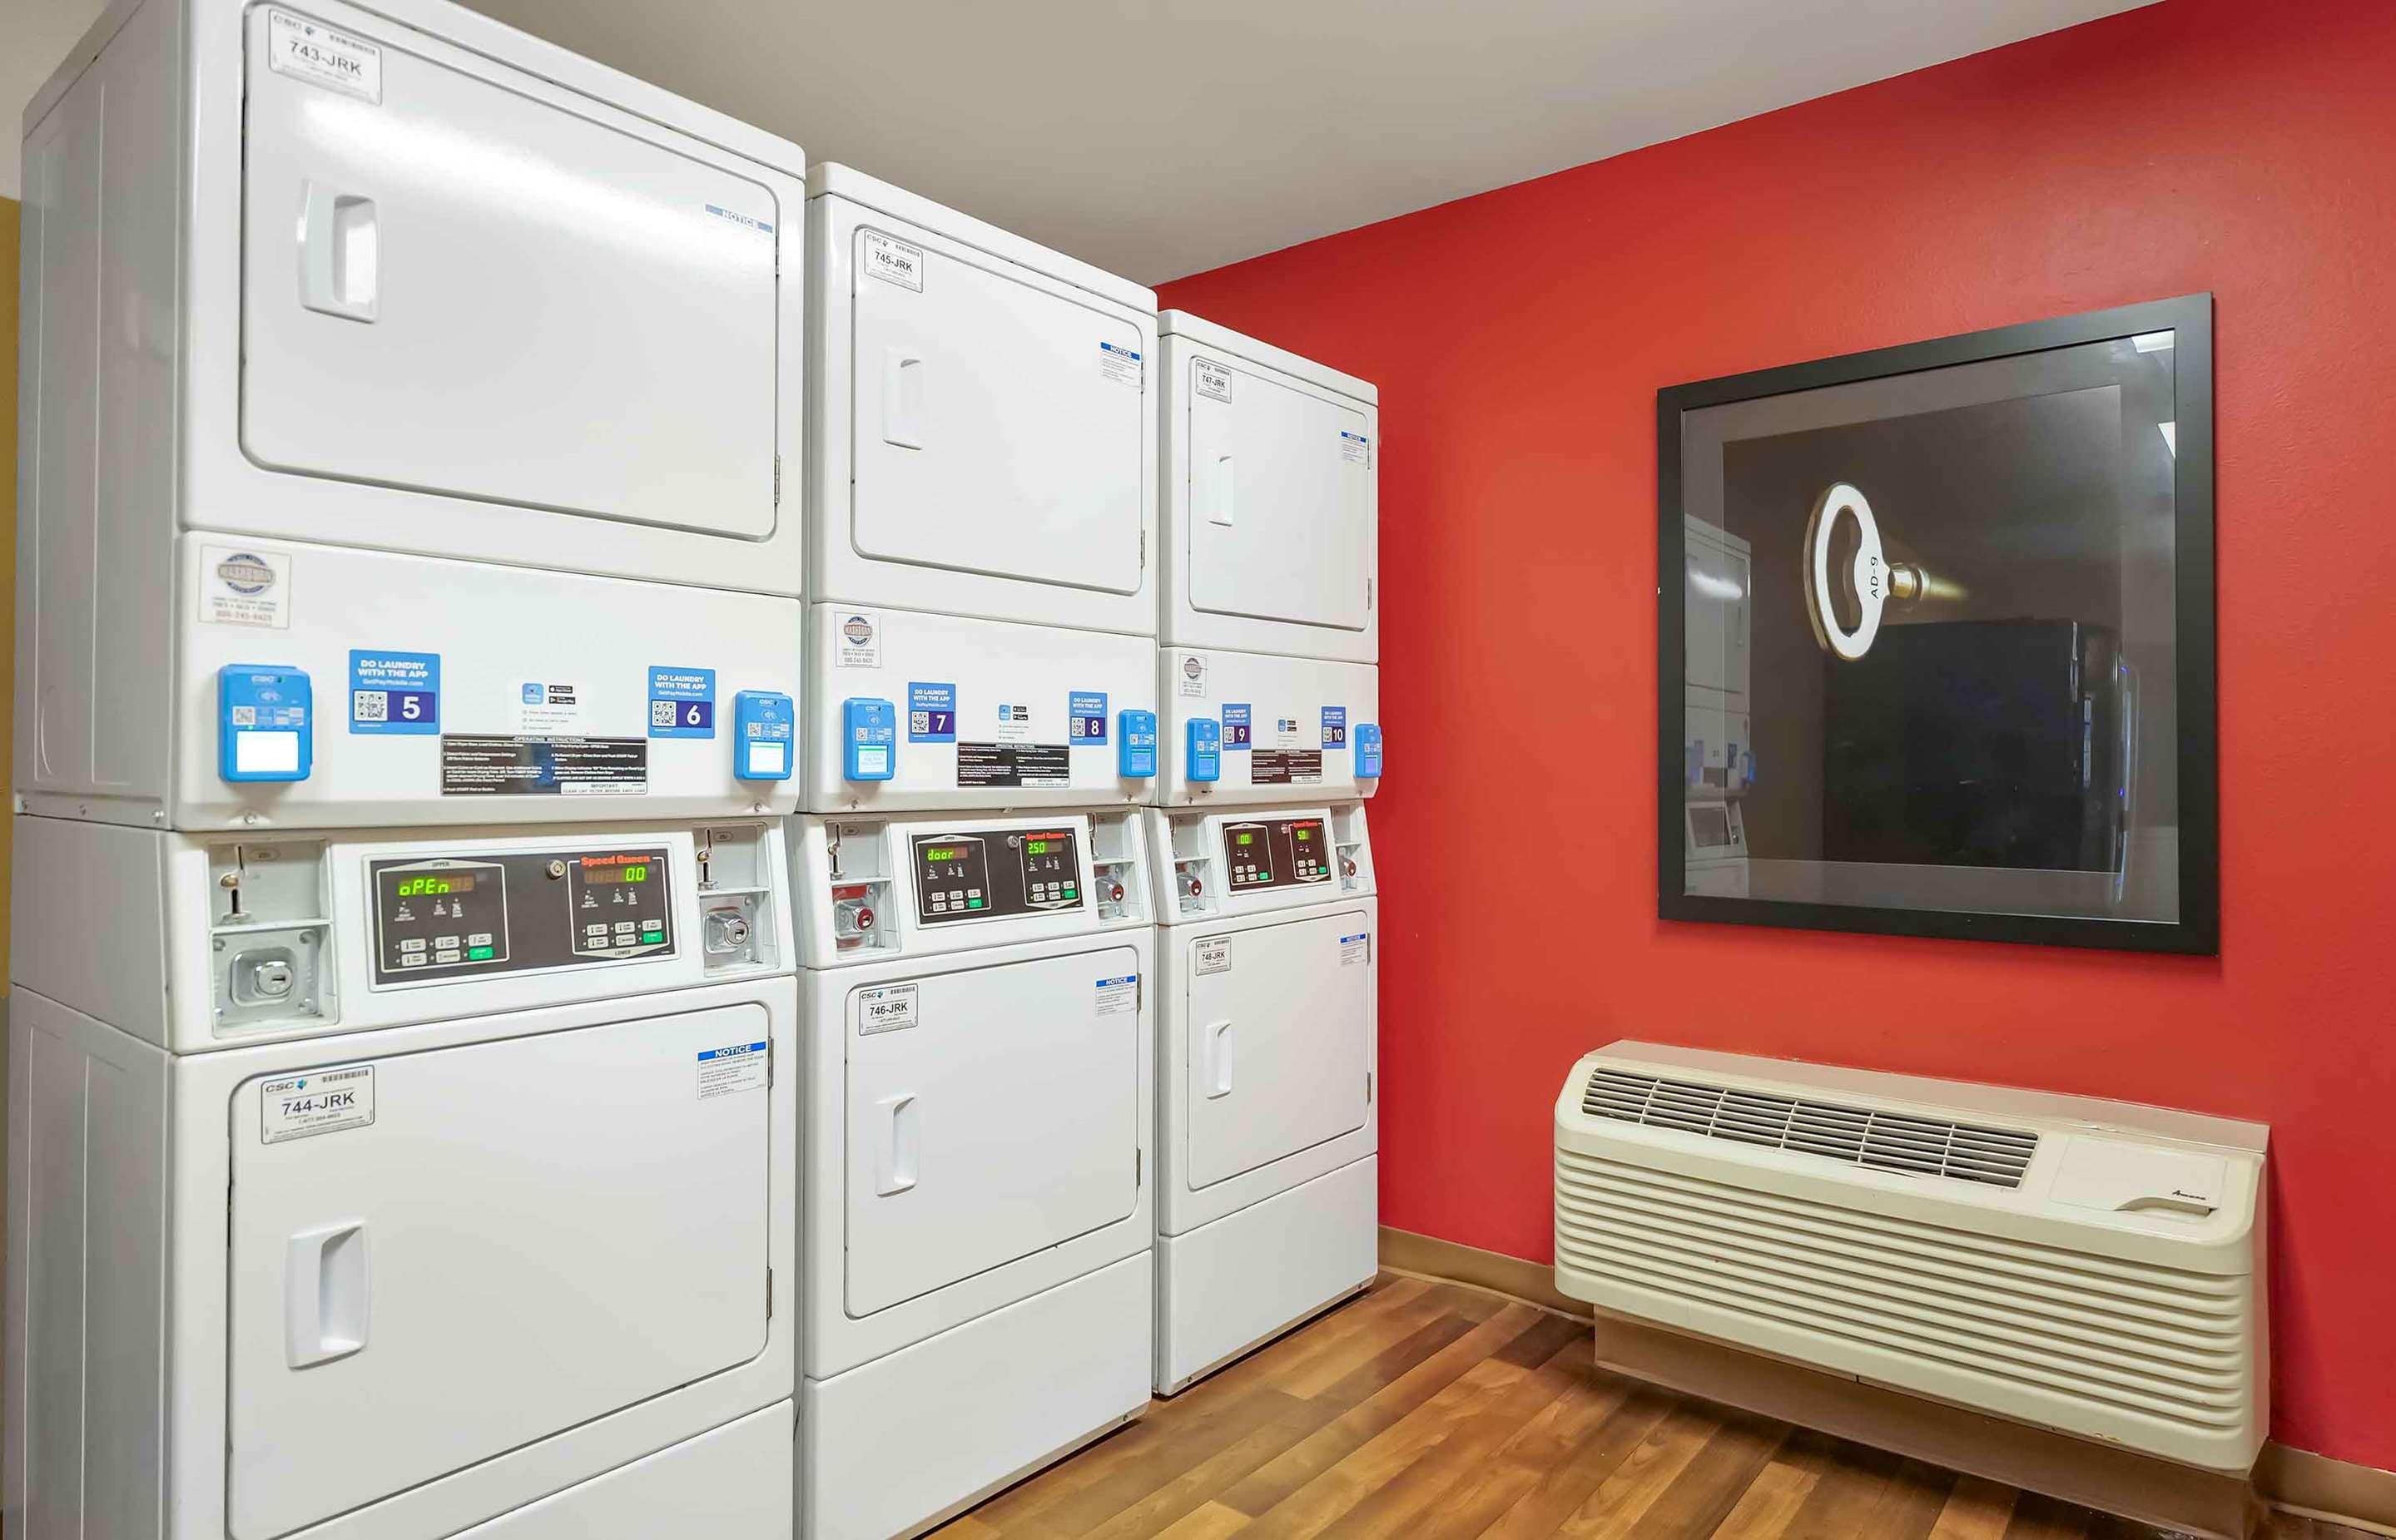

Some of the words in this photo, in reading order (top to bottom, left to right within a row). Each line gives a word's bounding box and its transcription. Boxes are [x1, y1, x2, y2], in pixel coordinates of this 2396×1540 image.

[290, 41, 362, 77] 743-JRK
[722, 210, 759, 229] NOTICE
[875, 251, 913, 273] 745-JRK
[1110, 345, 1132, 358] NOTICE
[1870, 557, 1878, 599] AD-9
[360, 659, 376, 668] DO
[378, 661, 425, 670] LAUNDRY
[358, 668, 384, 676] WITH
[387, 670, 407, 678] THE
[409, 671, 429, 679] APP
[670, 675, 705, 683] LAUNDRY
[402, 696, 421, 720] 5
[687, 705, 701, 725] 6
[936, 715, 946, 731] 7
[1091, 720, 1099, 735] 8
[1238, 728, 1246, 741] 9
[1333, 728, 1343, 741] 10
[581, 856, 616, 867] Speed
[617, 855, 651, 864] Queen
[626, 867, 646, 882] 00
[1105, 978, 1128, 986] NOTICE
[861, 992, 876, 1000] CSC
[870, 1002, 908, 1017] 746-JRK
[715, 1044, 752, 1057] NOTICE
[265, 1081, 295, 1093] CSC
[281, 1092, 355, 1117] 744-JRK
